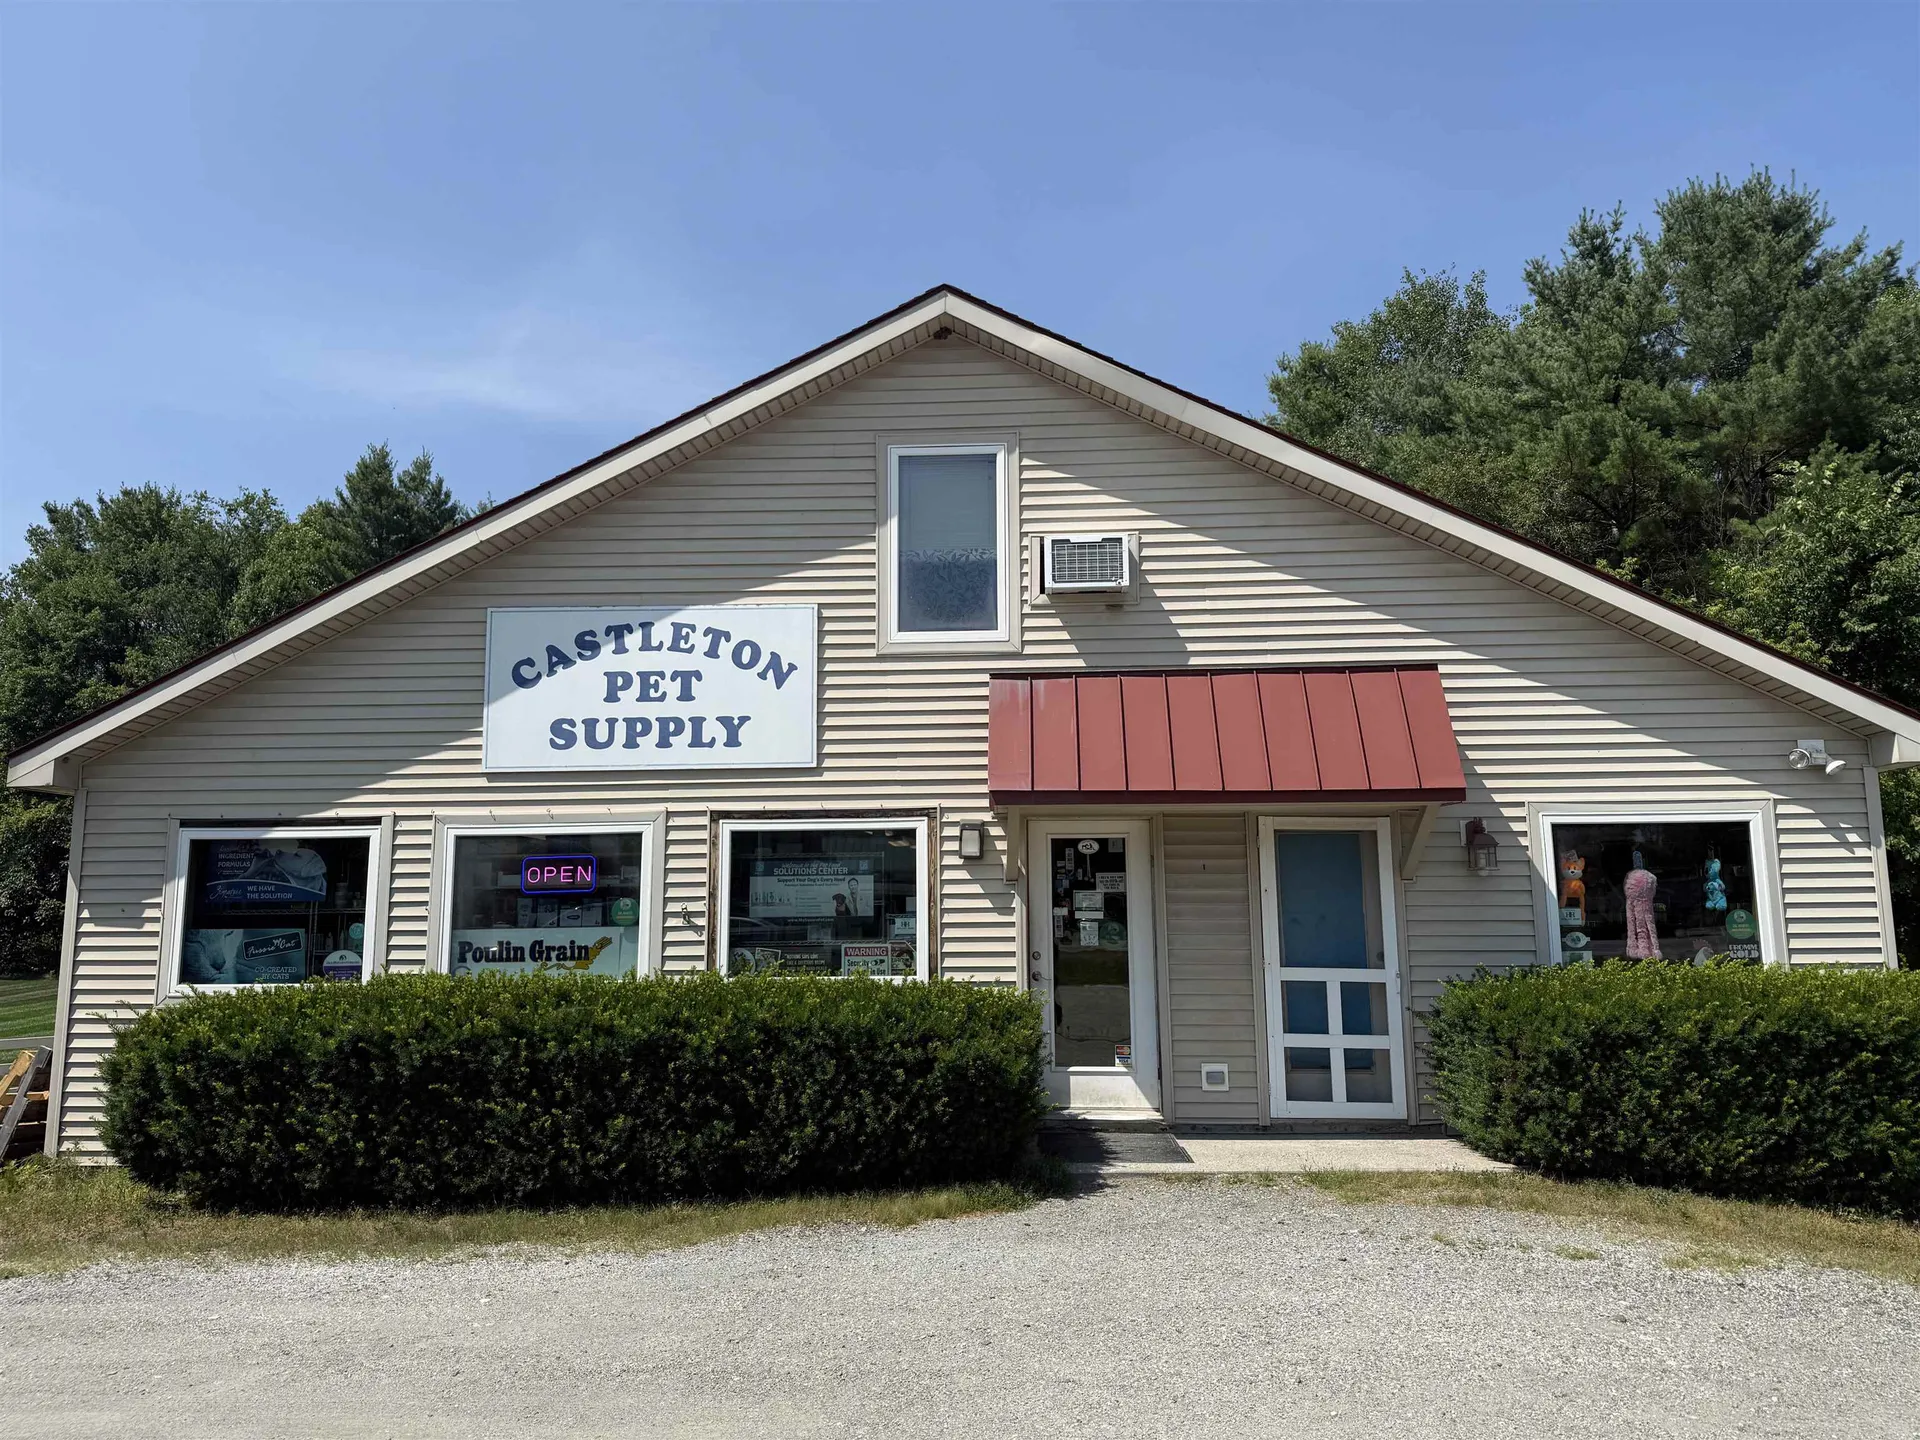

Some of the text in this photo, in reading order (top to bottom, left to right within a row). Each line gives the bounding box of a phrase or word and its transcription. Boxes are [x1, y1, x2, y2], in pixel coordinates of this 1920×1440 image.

[511, 620, 798, 690] CASTLETON
[603, 669, 703, 703] PET
[549, 715, 752, 751] SUPPLY
[527, 866, 592, 884] OPEN
[773, 867, 849, 876] SOLUTIONS CENTER
[457, 939, 590, 964] Poulin Grain
[847, 948, 887, 956] WARNING
[1729, 950, 1759, 959] GOLD
[876, 968, 886, 976] Use
